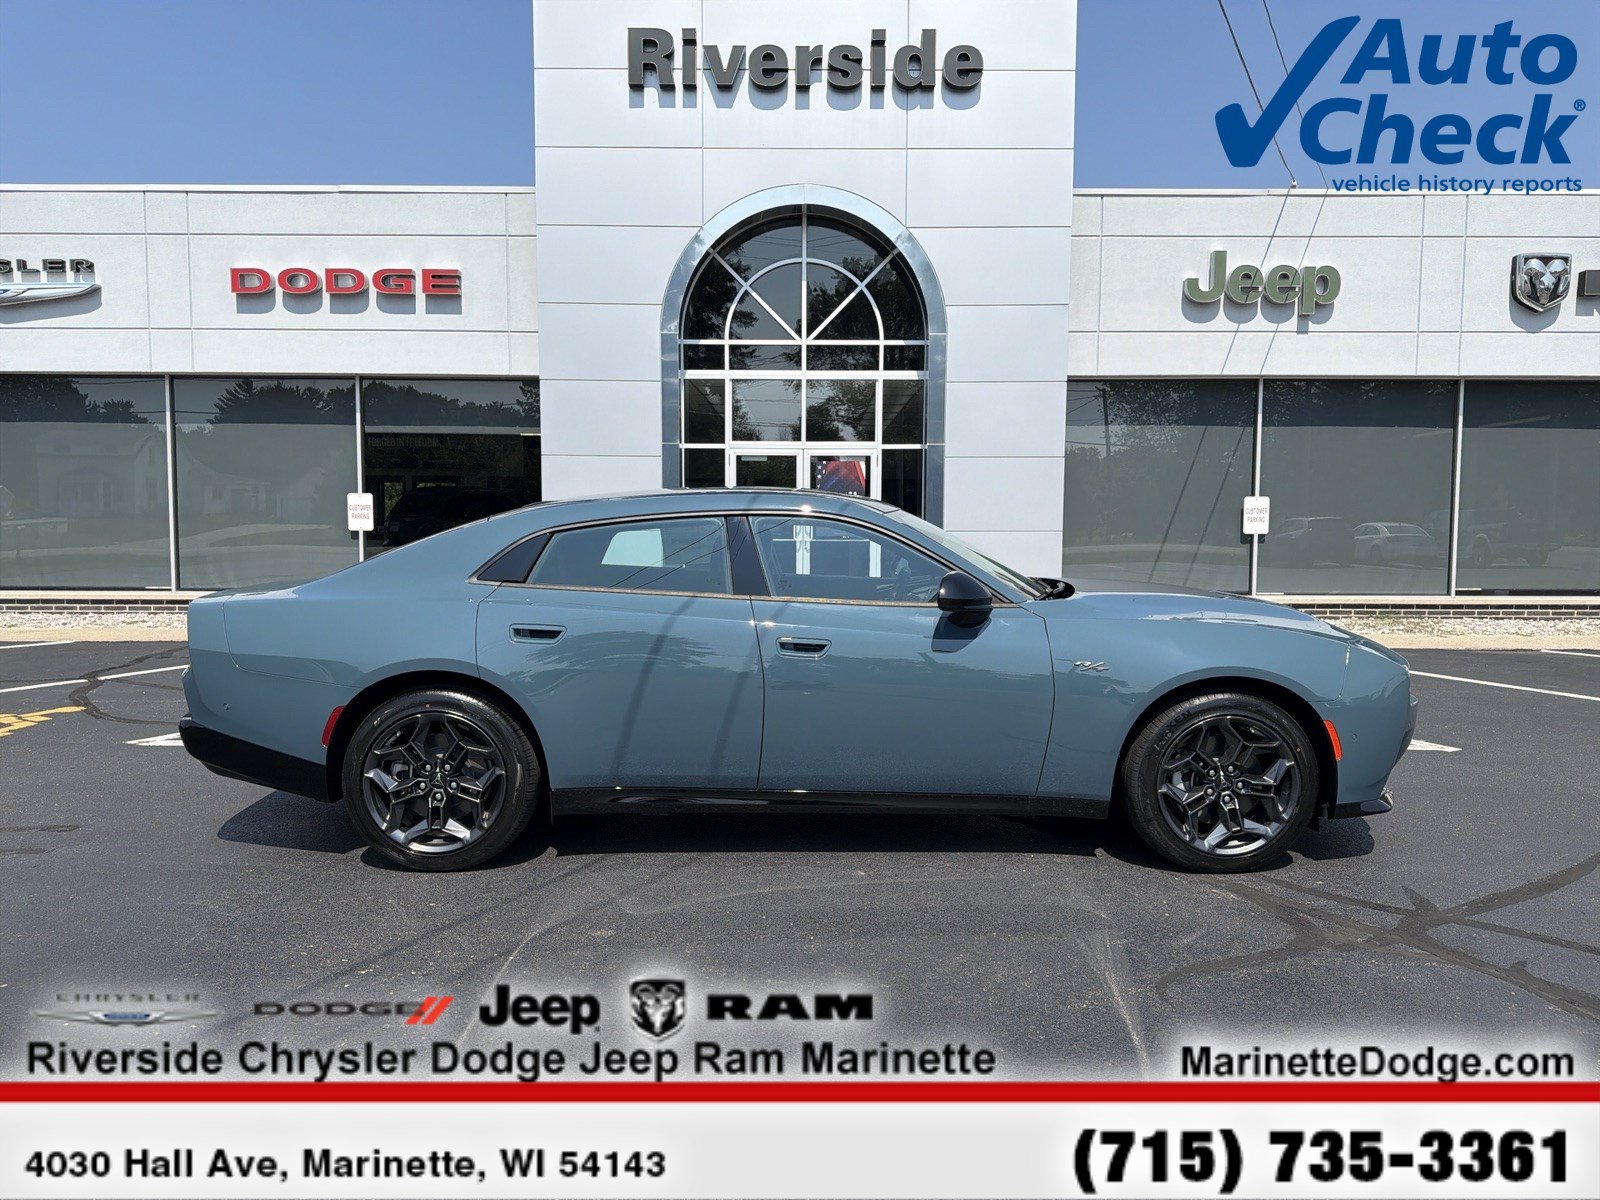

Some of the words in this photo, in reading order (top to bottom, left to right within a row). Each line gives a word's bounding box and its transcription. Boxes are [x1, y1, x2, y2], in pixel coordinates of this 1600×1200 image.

[626, 27, 985, 91] Riverside
[230, 267, 462, 295] DODGE
[1182, 250, 1342, 315] Jeep
[351, 512, 370, 520] PARKING
